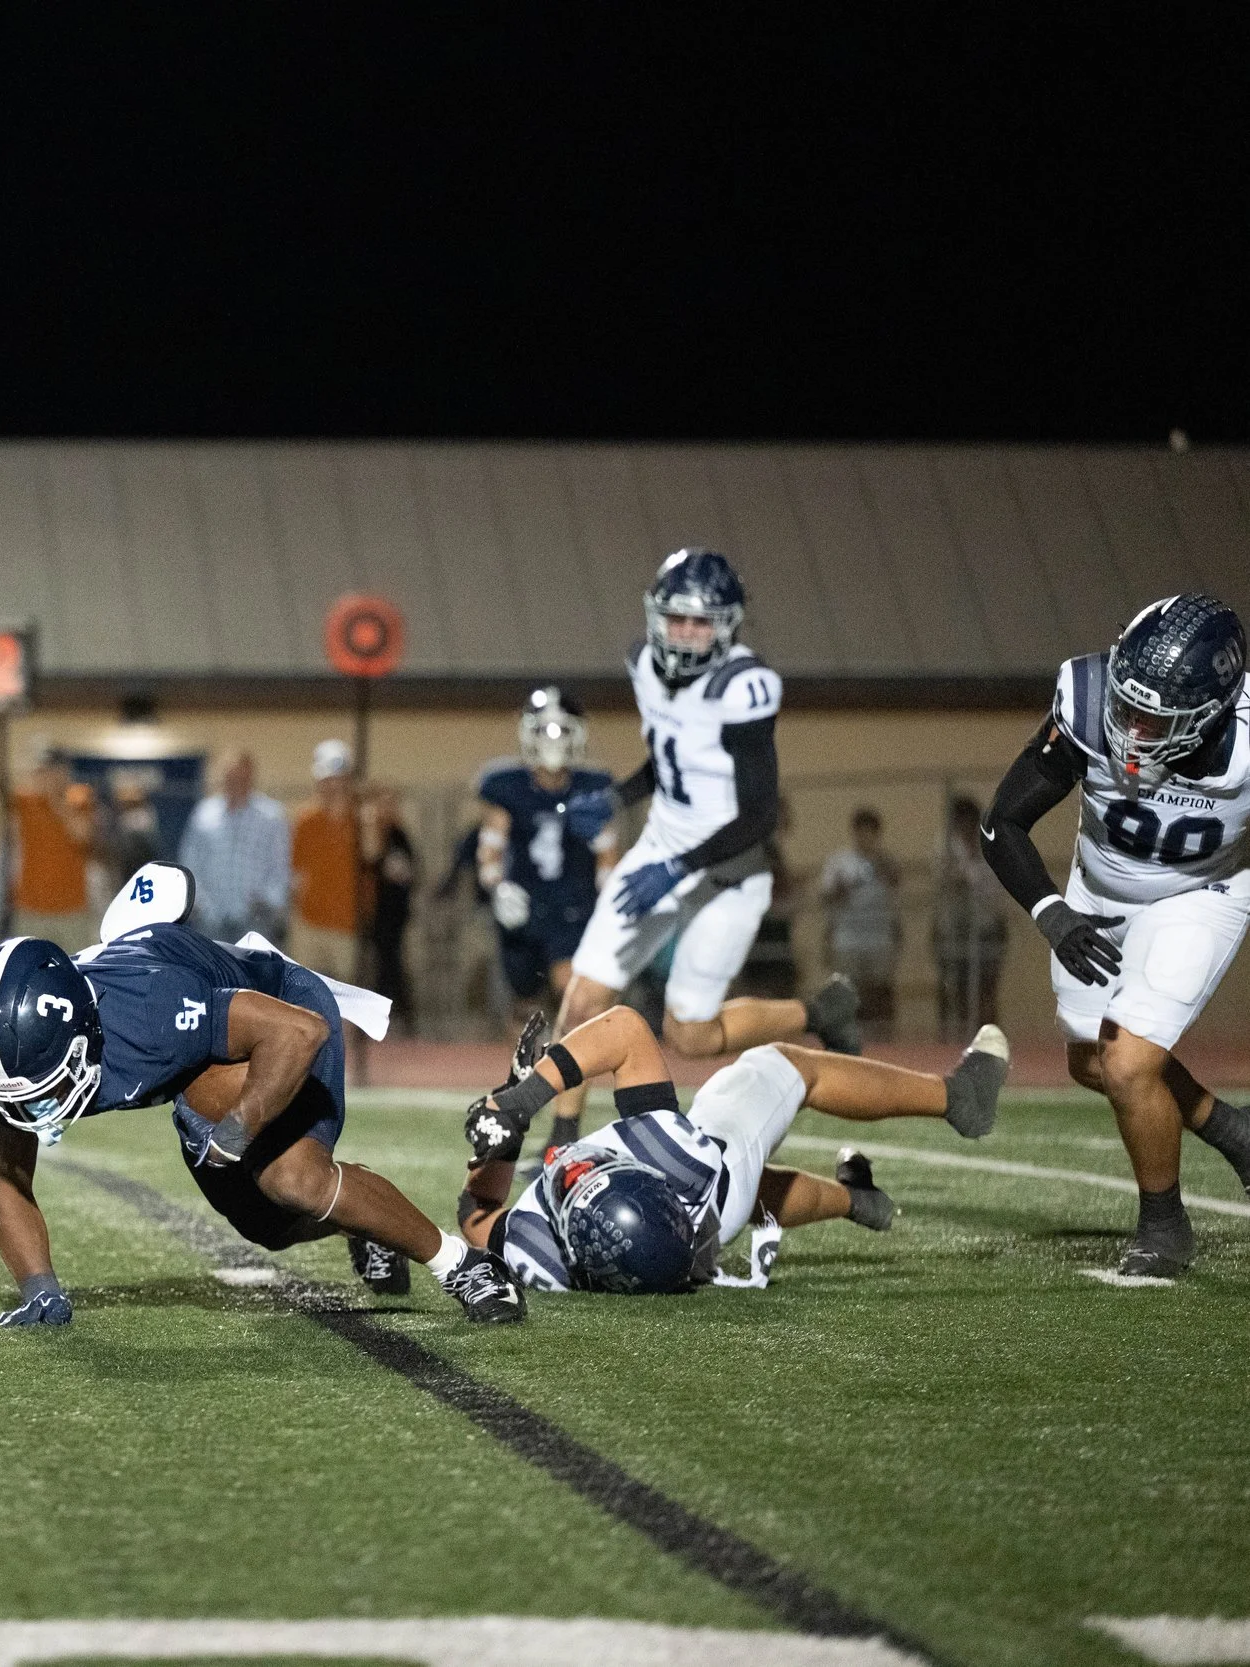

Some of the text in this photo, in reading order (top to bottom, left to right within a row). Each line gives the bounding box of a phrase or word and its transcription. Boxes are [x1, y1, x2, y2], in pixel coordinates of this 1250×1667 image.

[747, 678, 770, 708] 11
[1137, 788, 1216, 811] CHAMPION
[1103, 799, 1225, 866] 90
[37, 993, 74, 1022] 3
